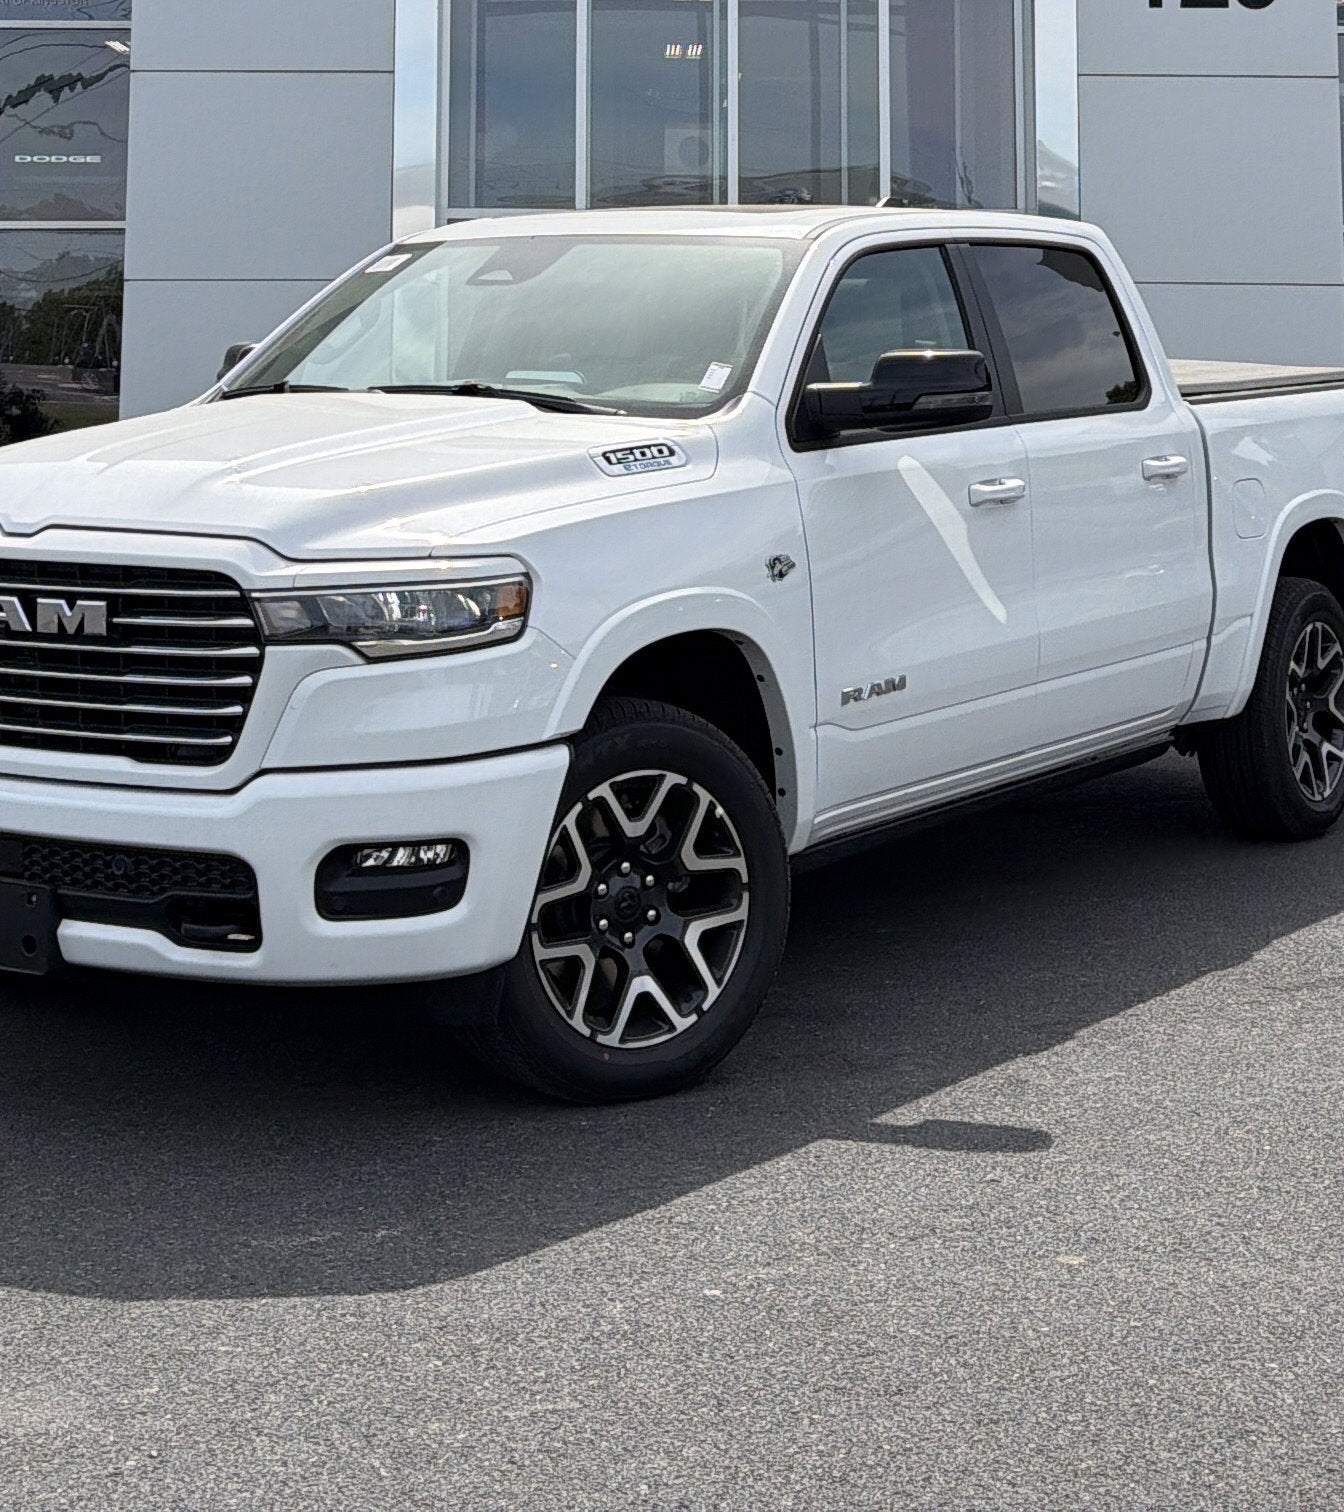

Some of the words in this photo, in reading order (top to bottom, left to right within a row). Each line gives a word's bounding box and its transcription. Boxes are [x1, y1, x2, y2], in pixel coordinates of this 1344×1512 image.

[14, 155, 102, 163] DODGE
[604, 445, 670, 465] 1500
[840, 674, 907, 707] RAM
